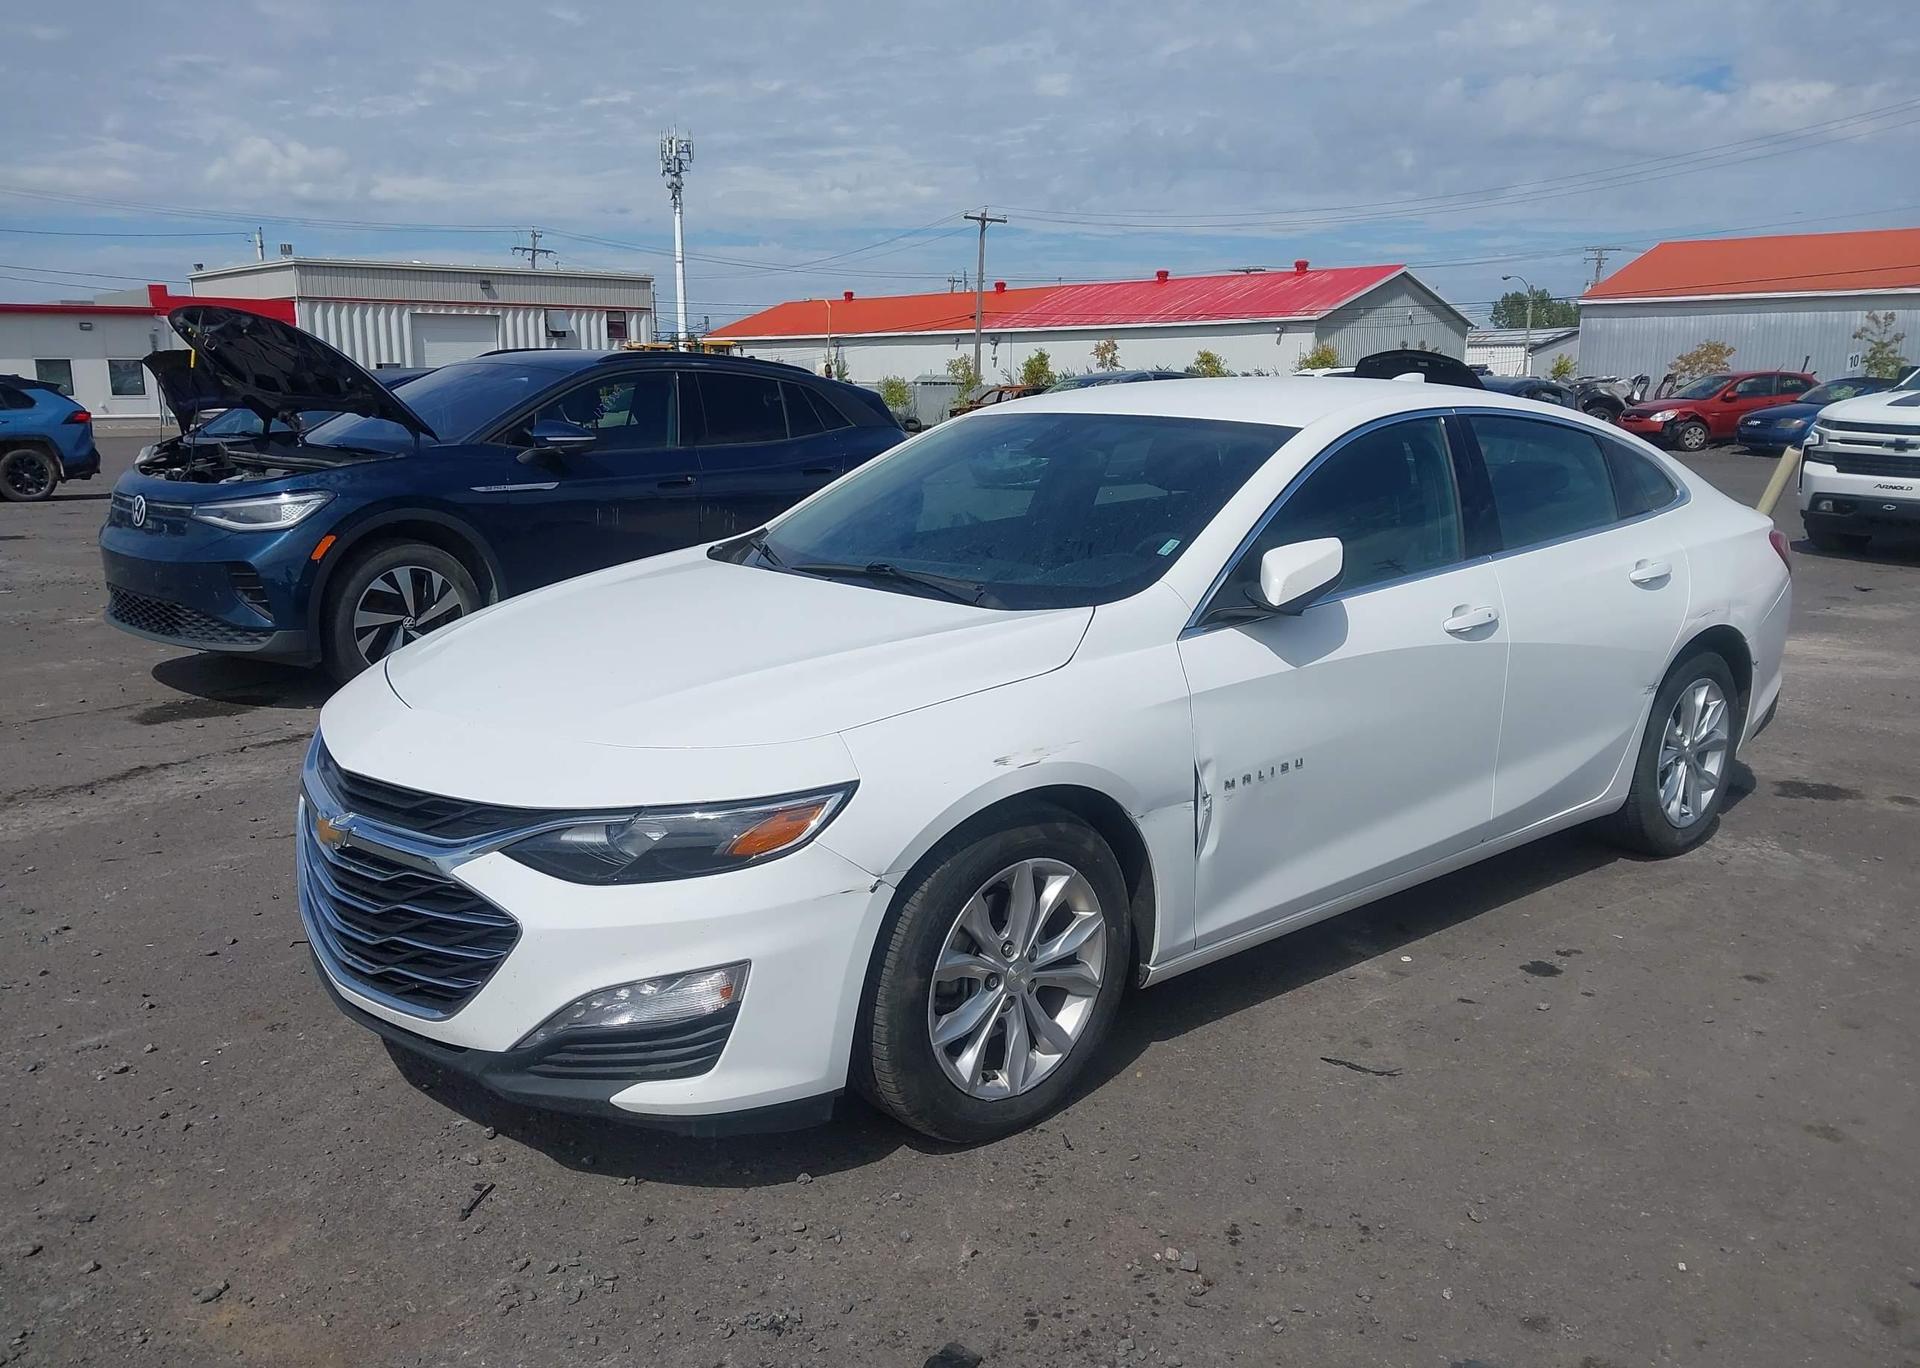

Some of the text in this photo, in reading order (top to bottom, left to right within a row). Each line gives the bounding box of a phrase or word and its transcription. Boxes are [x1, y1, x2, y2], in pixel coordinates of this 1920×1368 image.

[1849, 354, 1859, 368] 10
[1873, 483, 1913, 491] ARNOLD
[1223, 757, 1304, 792] MALIBU
